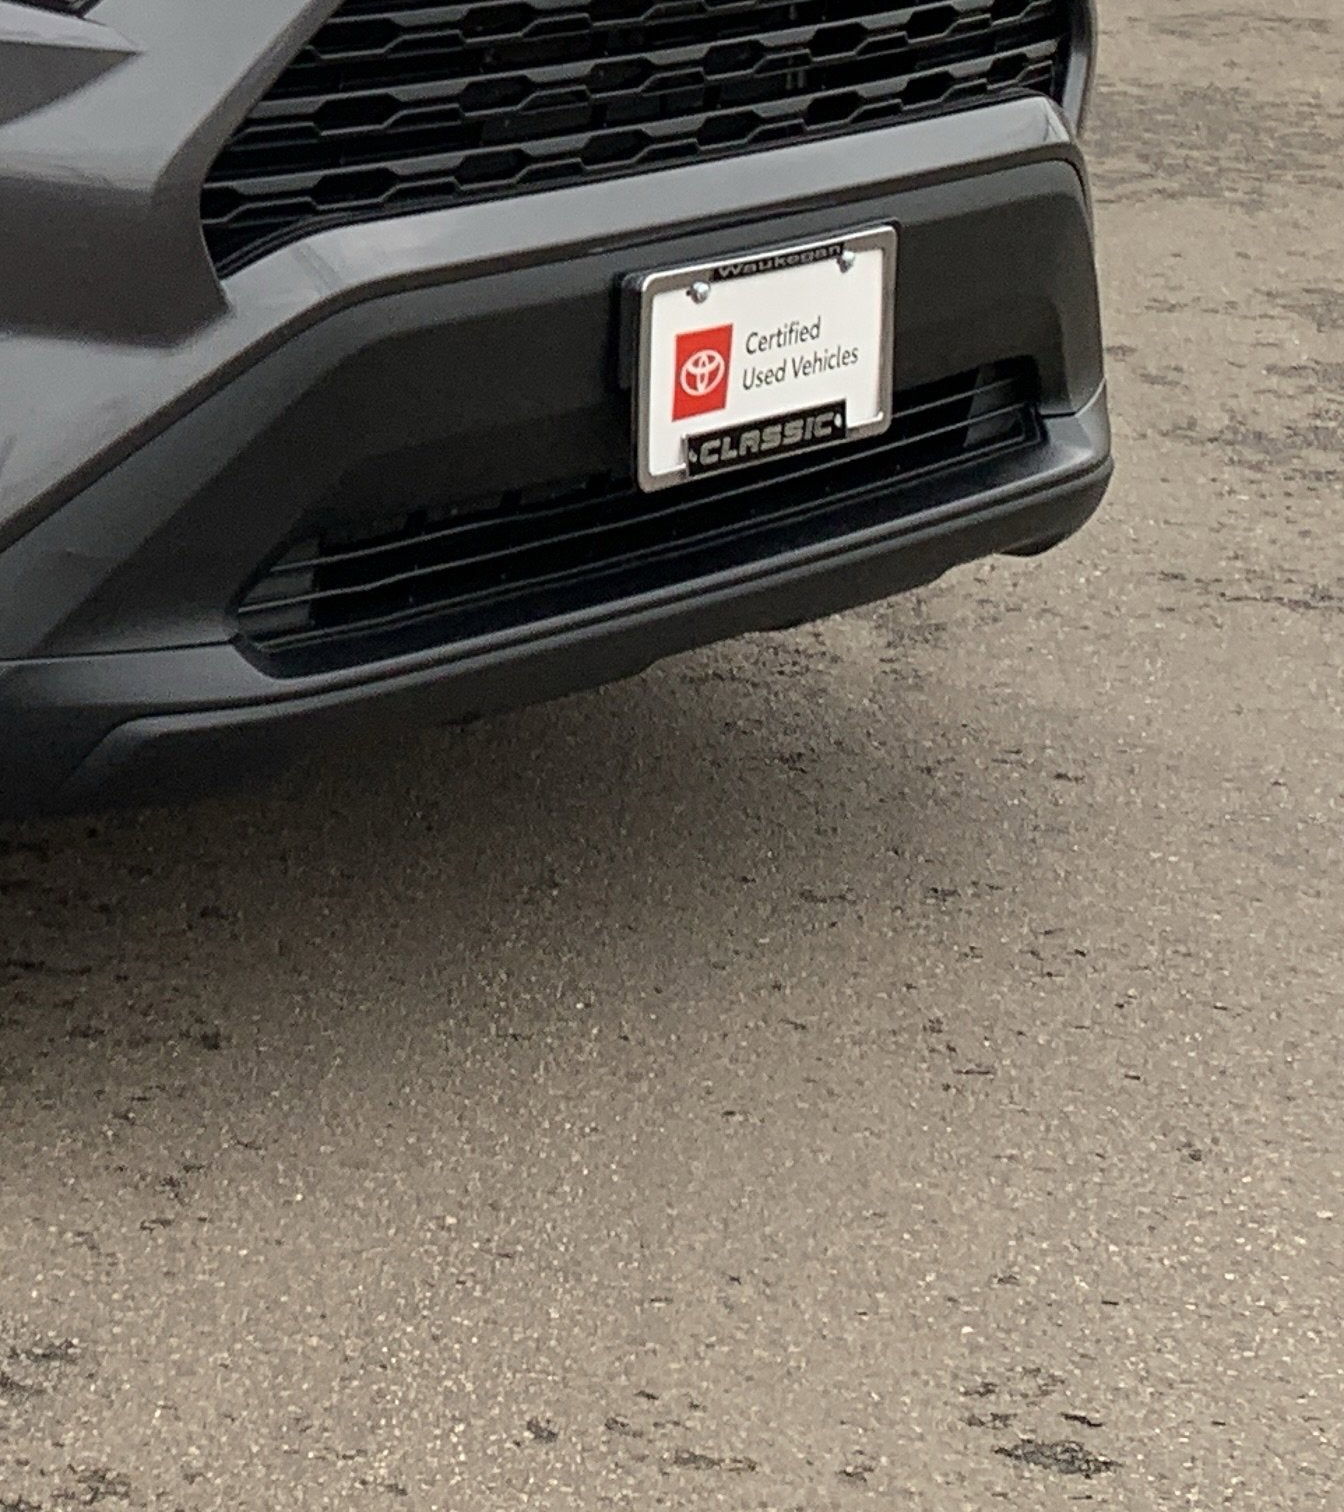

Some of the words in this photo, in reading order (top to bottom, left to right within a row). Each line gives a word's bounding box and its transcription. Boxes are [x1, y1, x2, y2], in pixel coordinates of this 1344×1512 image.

[717, 244, 842, 278] Waukegan
[744, 315, 822, 355] Certified
[742, 360, 787, 391] Used
[791, 345, 859, 379] Vehicles
[699, 411, 835, 466] CLASSIC
